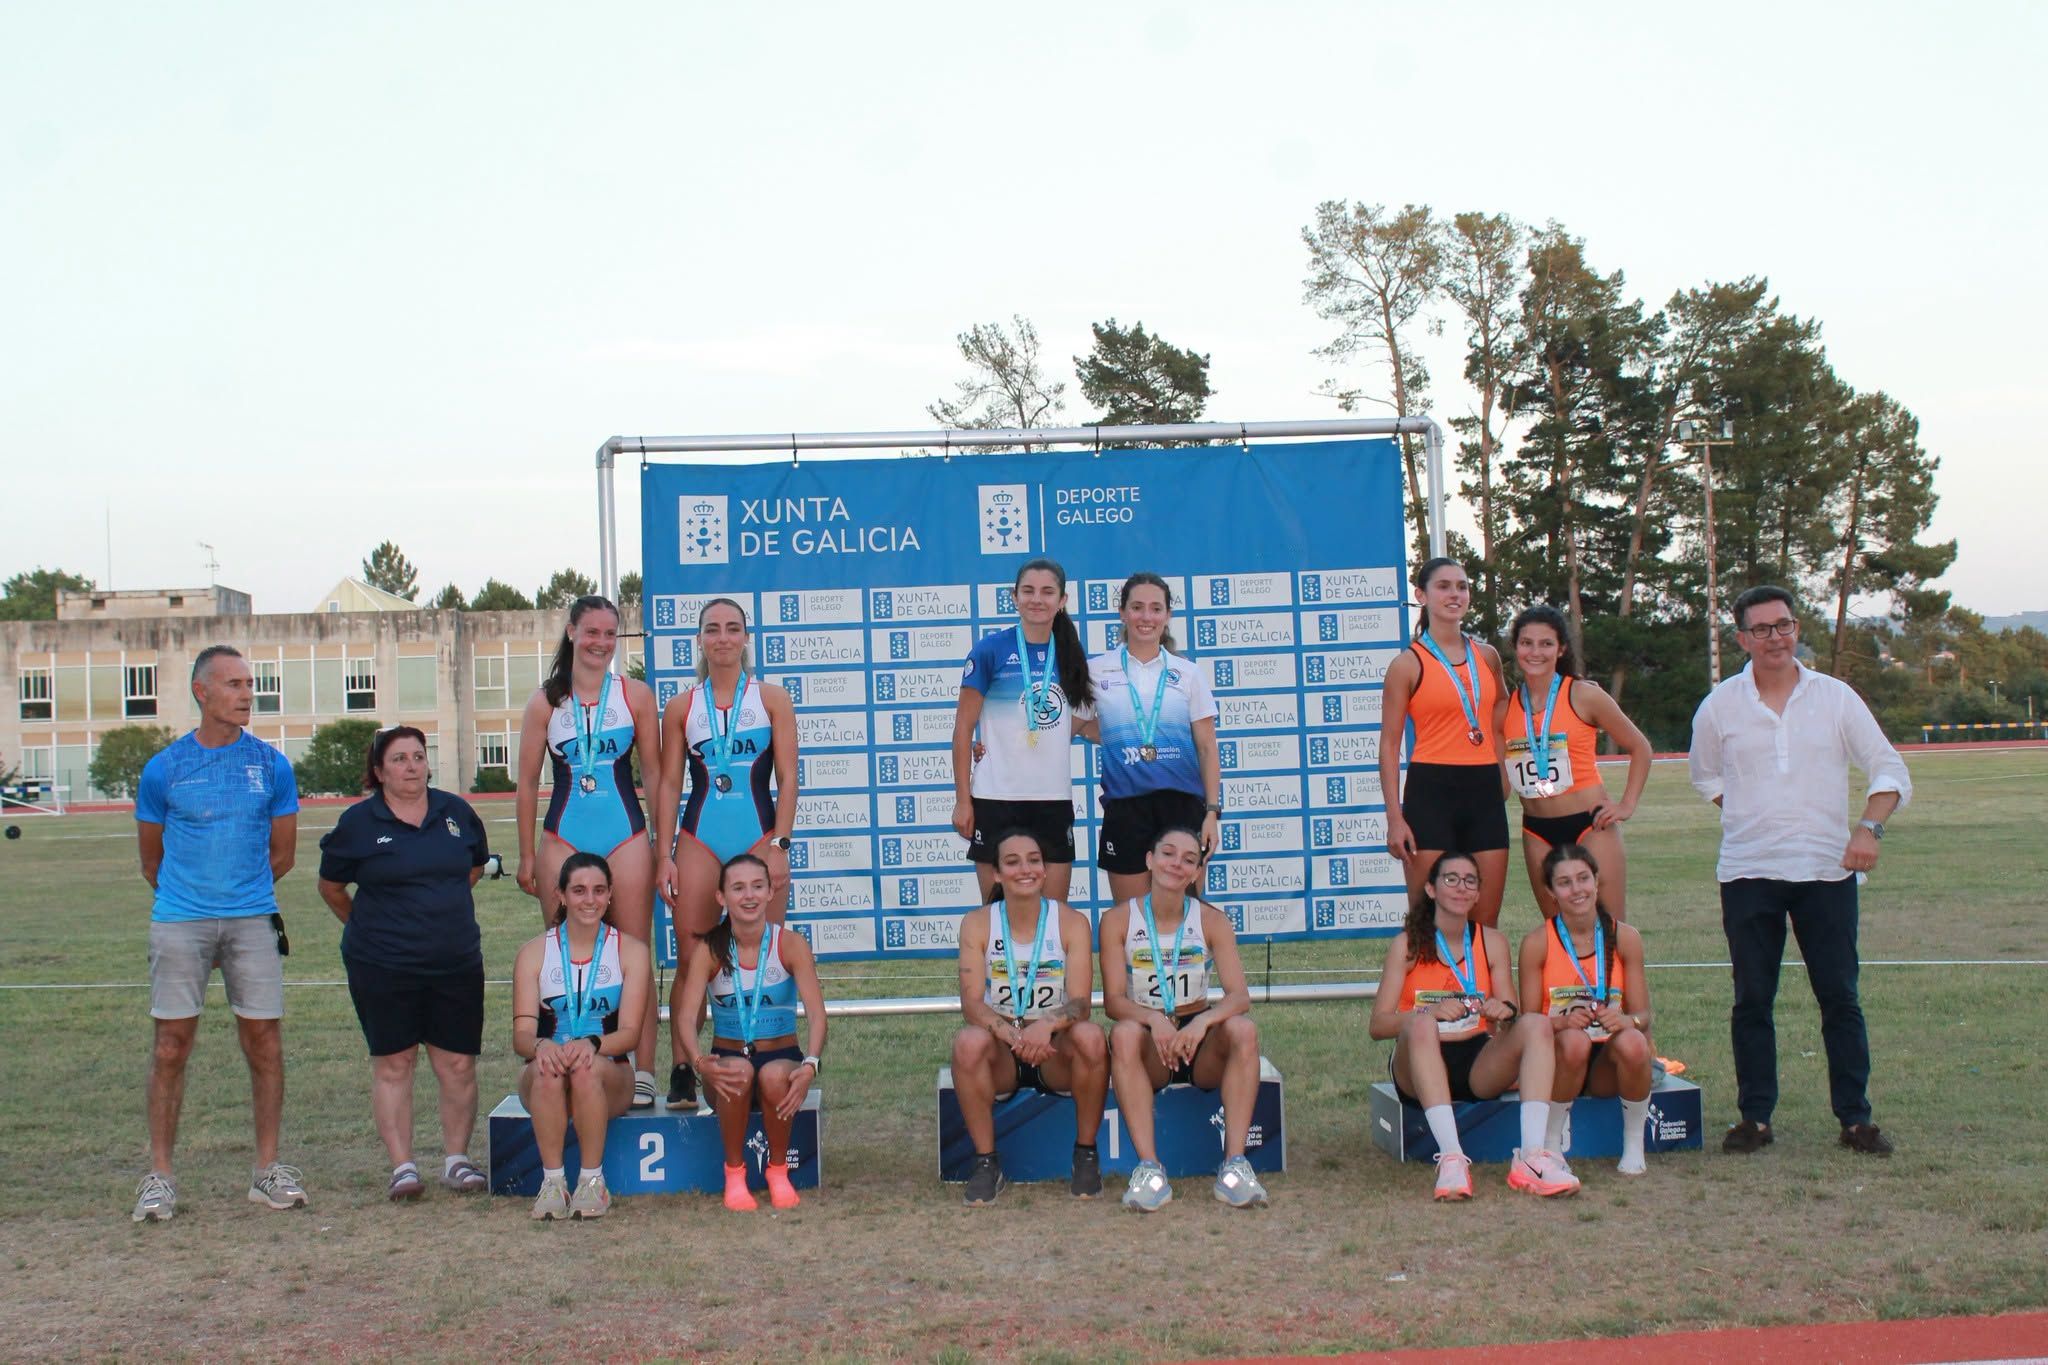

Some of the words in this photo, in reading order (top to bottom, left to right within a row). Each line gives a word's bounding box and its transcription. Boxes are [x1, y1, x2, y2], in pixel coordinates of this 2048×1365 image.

[1056, 487, 1141, 505] DEPORTE
[741, 497, 851, 525] XUNTA
[1057, 507, 1133, 526] GALEGO
[741, 531, 779, 557] DE
[792, 526, 921, 555] GALICIA
[1326, 575, 1368, 586] XUNTA
[898, 592, 940, 603] XUNTA
[1326, 588, 1342, 598] DE
[1345, 586, 1395, 598] GALICIA
[680, 600, 706, 611] XUN
[810, 603, 842, 611] GALEGO
[898, 606, 913, 616] DE
[918, 604, 968, 615] GALICIA
[680, 613, 696, 623] DE
[1349, 614, 1382, 622] DEPORTE
[1221, 620, 1263, 631] XUNTA
[1349, 622, 1379, 630] GALEGO
[920, 632, 953, 640] DEPORTE
[1221, 634, 1236, 644] DE
[1242, 632, 1291, 643] GALICIA
[791, 637, 834, 648] XUNTA
[920, 640, 951, 648] GALEGO
[790, 650, 806, 660] DE
[811, 648, 861, 660] GALICIA
[1244, 660, 1277, 668] DEPORTE
[1329, 656, 1372, 667] XUNTA
[900, 674, 943, 685] XUNTA
[1330, 670, 1345, 680] DE
[1350, 668, 1386, 678] GALIC
[813, 677, 847, 685] DEPORTE
[813, 686, 845, 694] GALEGO
[900, 688, 916, 698] DE
[921, 686, 960, 697] GALIC
[1225, 702, 1268, 712] XUNTA
[1225, 715, 1240, 725] DE
[1245, 713, 1295, 724] GALICIA
[924, 722, 954, 730] GALEGO
[814, 730, 864, 742] GALICIA
[1334, 738, 1376, 748] XUNTA
[904, 756, 946, 766] XUNTA
[1334, 751, 1349, 761] DE
[904, 769, 919, 780] DE
[924, 768, 952, 779] GALI
[1357, 777, 1380, 785] DEPOR
[1229, 783, 1271, 794] XUNTA
[927, 796, 956, 804] DEPORT
[1229, 797, 1244, 807] DE
[1248, 794, 1299, 805] GALICIA
[796, 814, 812, 825] DE
[817, 812, 868, 824] GALICIA
[1337, 819, 1378, 829] XUNTA
[1337, 832, 1352, 843] DE
[1357, 831, 1386, 841] GALI
[819, 842, 852, 850] DEPORTE
[906, 839, 949, 849] XUNTA
[820, 850, 850, 858] GALEGO
[906, 852, 921, 862] DE
[927, 851, 965, 861] GALIC
[1359, 858, 1392, 866] DEPORTE
[1232, 864, 1274, 876] XUNTA
[1360, 866, 1389, 874] GALEGO
[1232, 878, 1247, 888] DE
[1252, 876, 1302, 887] GALICIA
[800, 884, 843, 894] XUNTA
[800, 897, 816, 907] DE
[820, 895, 871, 906] GALICIA
[1339, 900, 1382, 911] XUNTA
[1255, 905, 1288, 913] DEPORTE
[1340, 914, 1355, 923] DE
[1359, 912, 1406, 922] GALICIA
[823, 924, 856, 932] DEPORTE
[910, 921, 953, 932] XUNTA
[823, 932, 854, 940] GALEGO
[910, 934, 926, 945] DE
[931, 933, 960, 944] GALI
[1104, 1108, 1120, 1159] 1
[640, 1132, 664, 1181] 2
